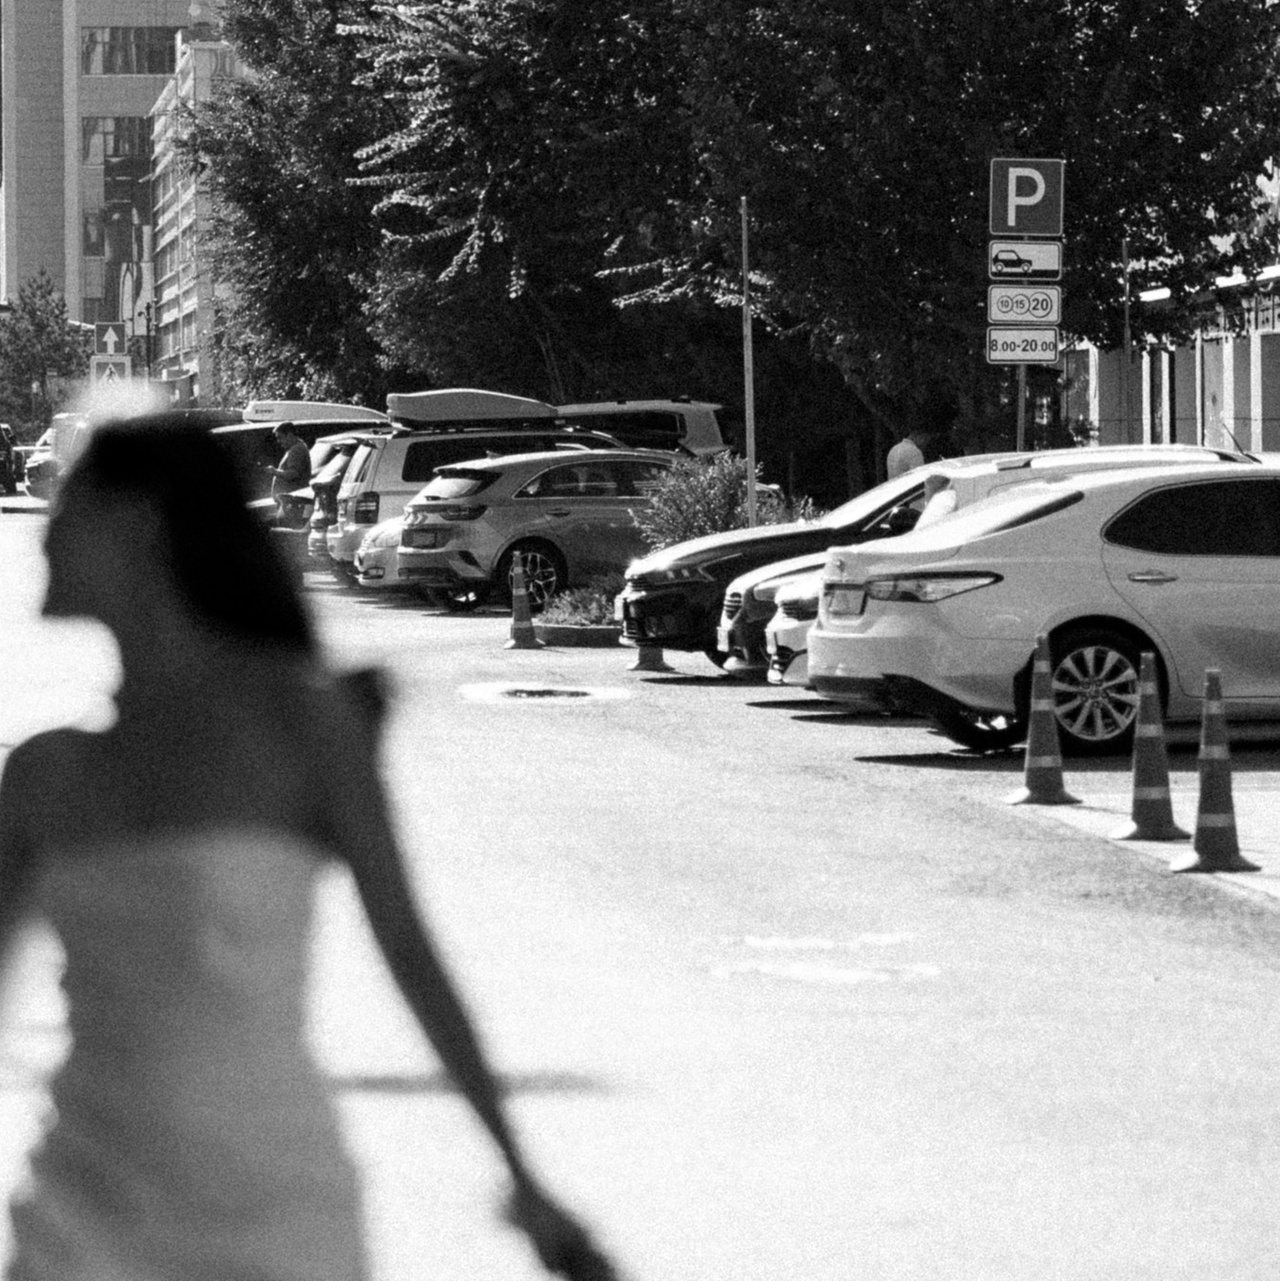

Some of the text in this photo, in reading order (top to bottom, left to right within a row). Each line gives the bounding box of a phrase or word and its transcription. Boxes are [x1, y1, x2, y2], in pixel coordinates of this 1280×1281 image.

[1008, 167, 1046, 226] P
[1000, 298, 1049, 311] 10 15 20
